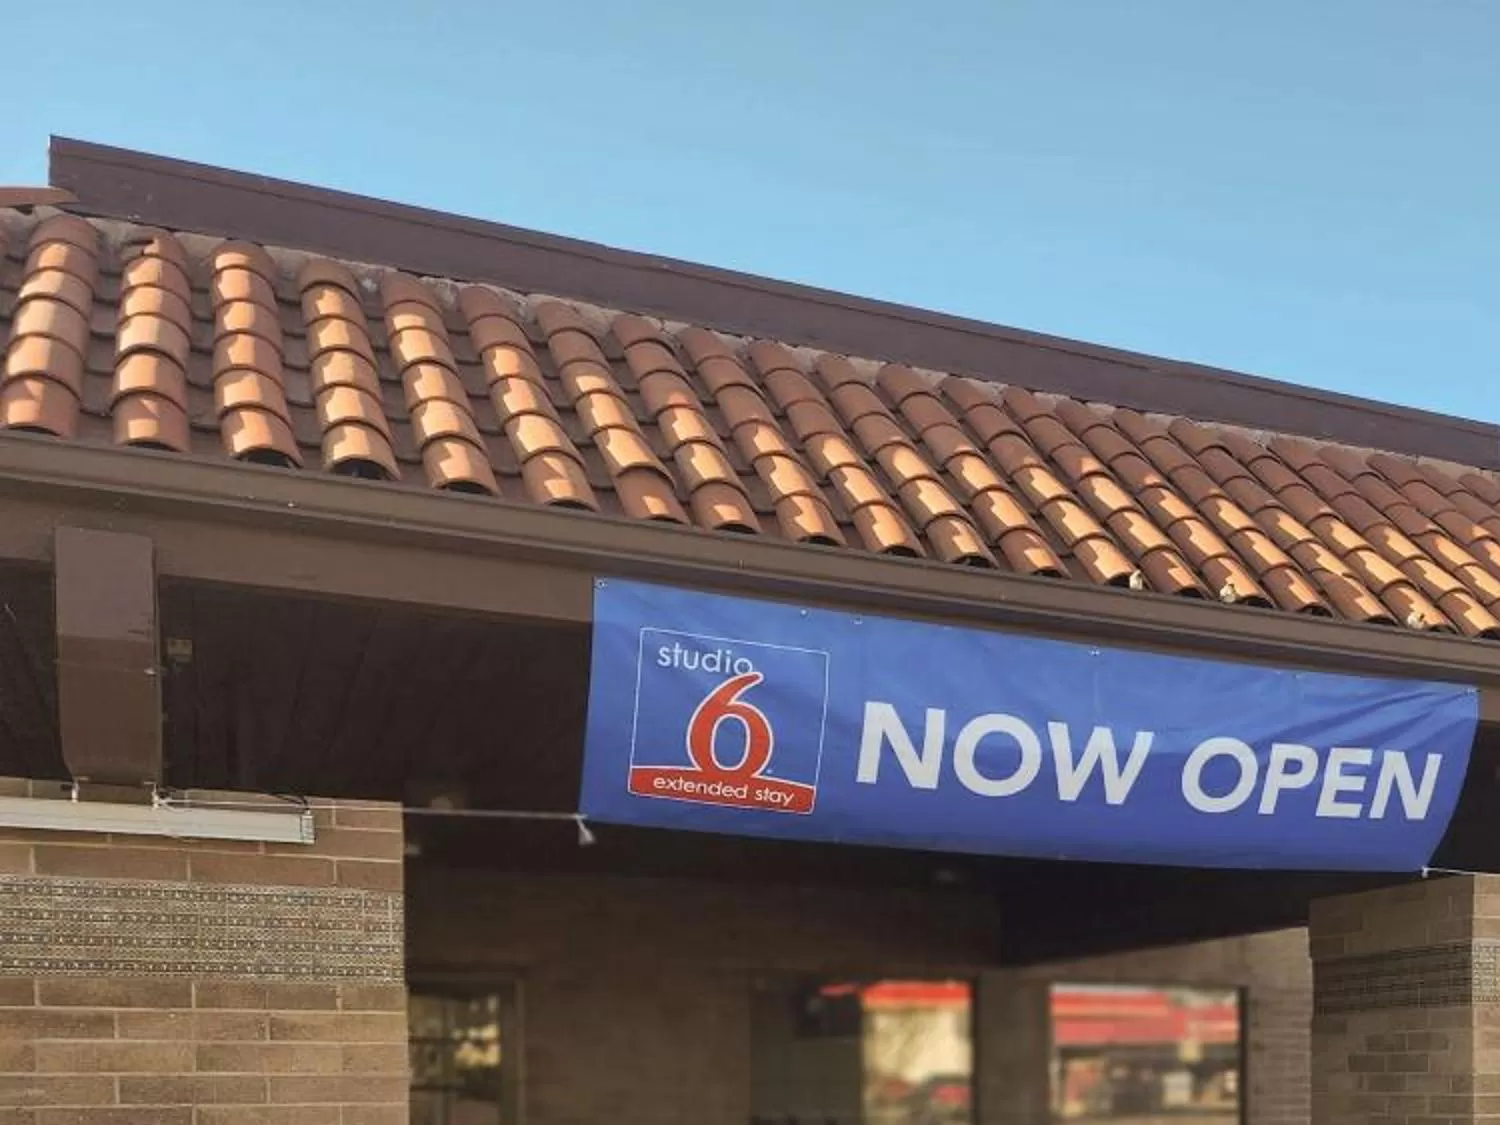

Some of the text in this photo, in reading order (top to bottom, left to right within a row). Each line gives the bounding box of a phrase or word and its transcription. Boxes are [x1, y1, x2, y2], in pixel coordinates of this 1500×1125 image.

[657, 643, 754, 674] studio
[686, 671, 775, 777] 6
[653, 775, 796, 807] extended stay
[856, 700, 1443, 821] NOW OPEN
